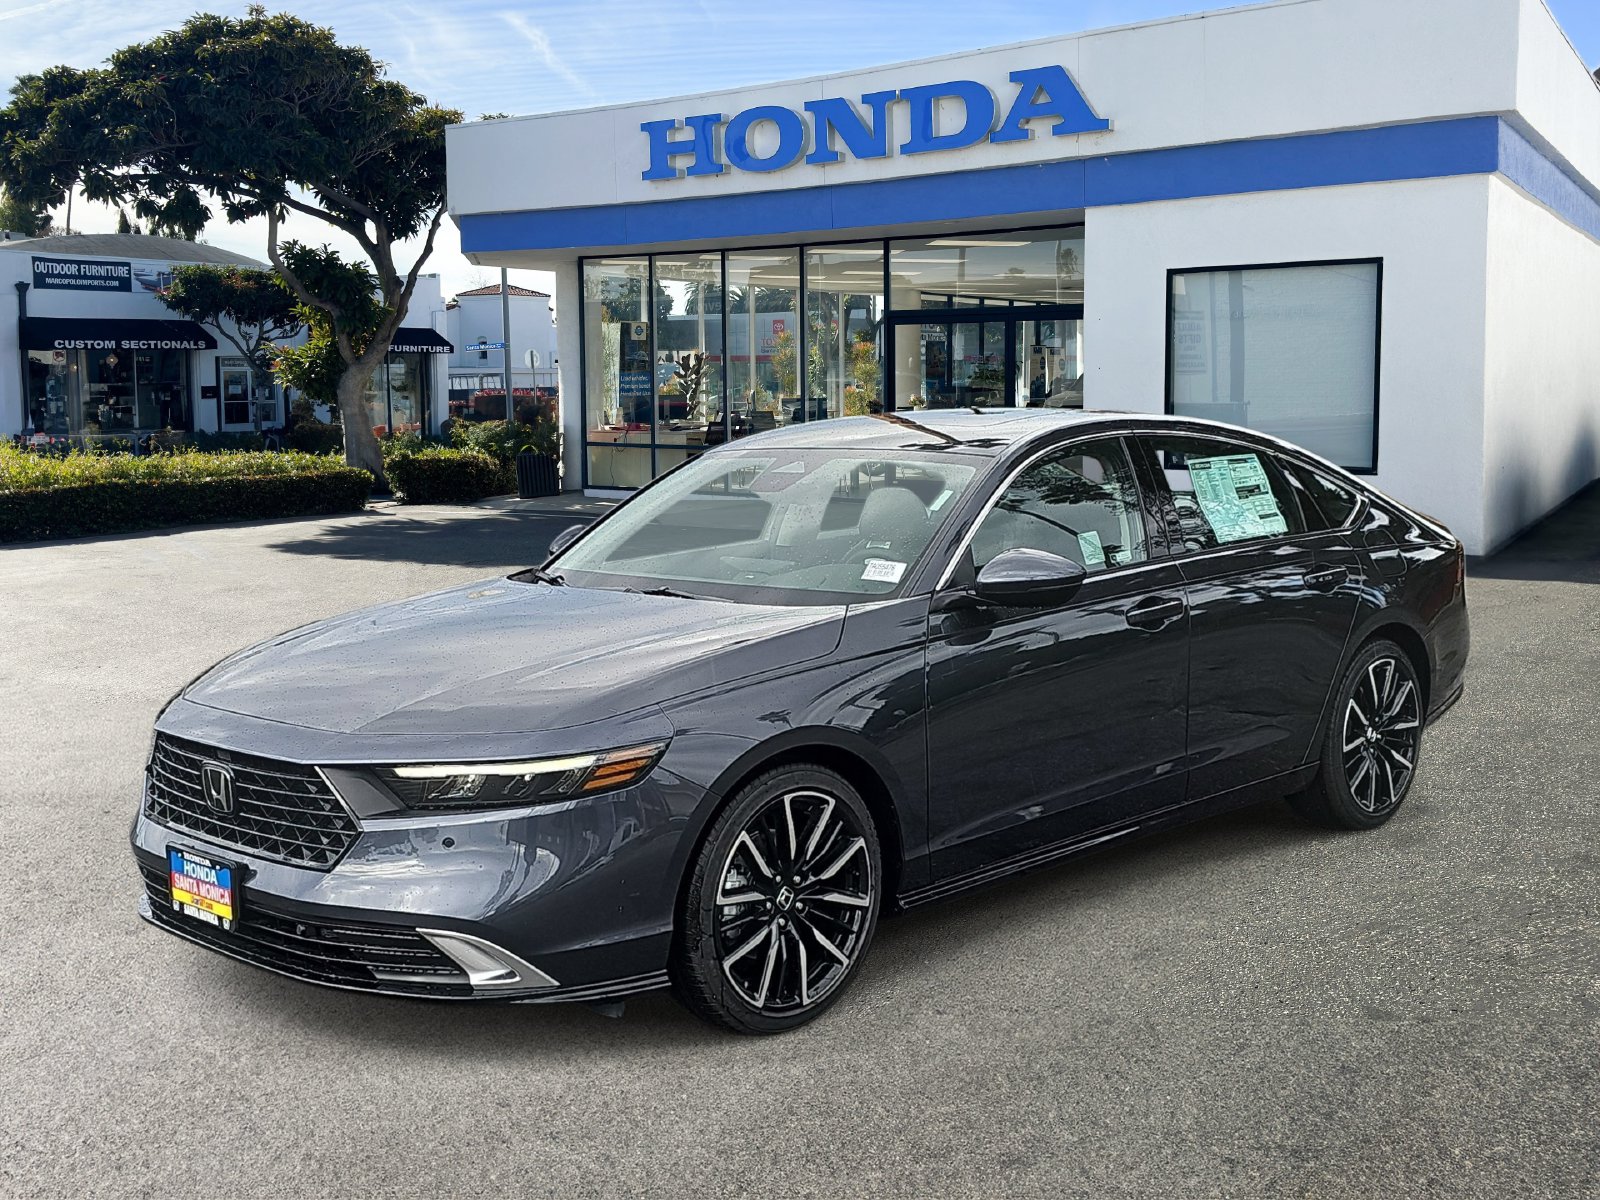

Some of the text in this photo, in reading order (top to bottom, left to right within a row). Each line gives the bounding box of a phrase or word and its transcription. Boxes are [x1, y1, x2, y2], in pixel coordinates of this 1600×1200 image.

[640, 65, 1113, 181] HONDA
[34, 261, 129, 277] OUTDOOR FURNITURE
[45, 277, 119, 287] MARCOPOLOIMPORTS.COM
[54, 339, 206, 349] CUSTOM SECTIONALS
[388, 344, 451, 353] FURNITURE
[183, 860, 218, 885] HONDA
[174, 873, 199, 895] SANTA
[198, 882, 230, 905] MONICA
